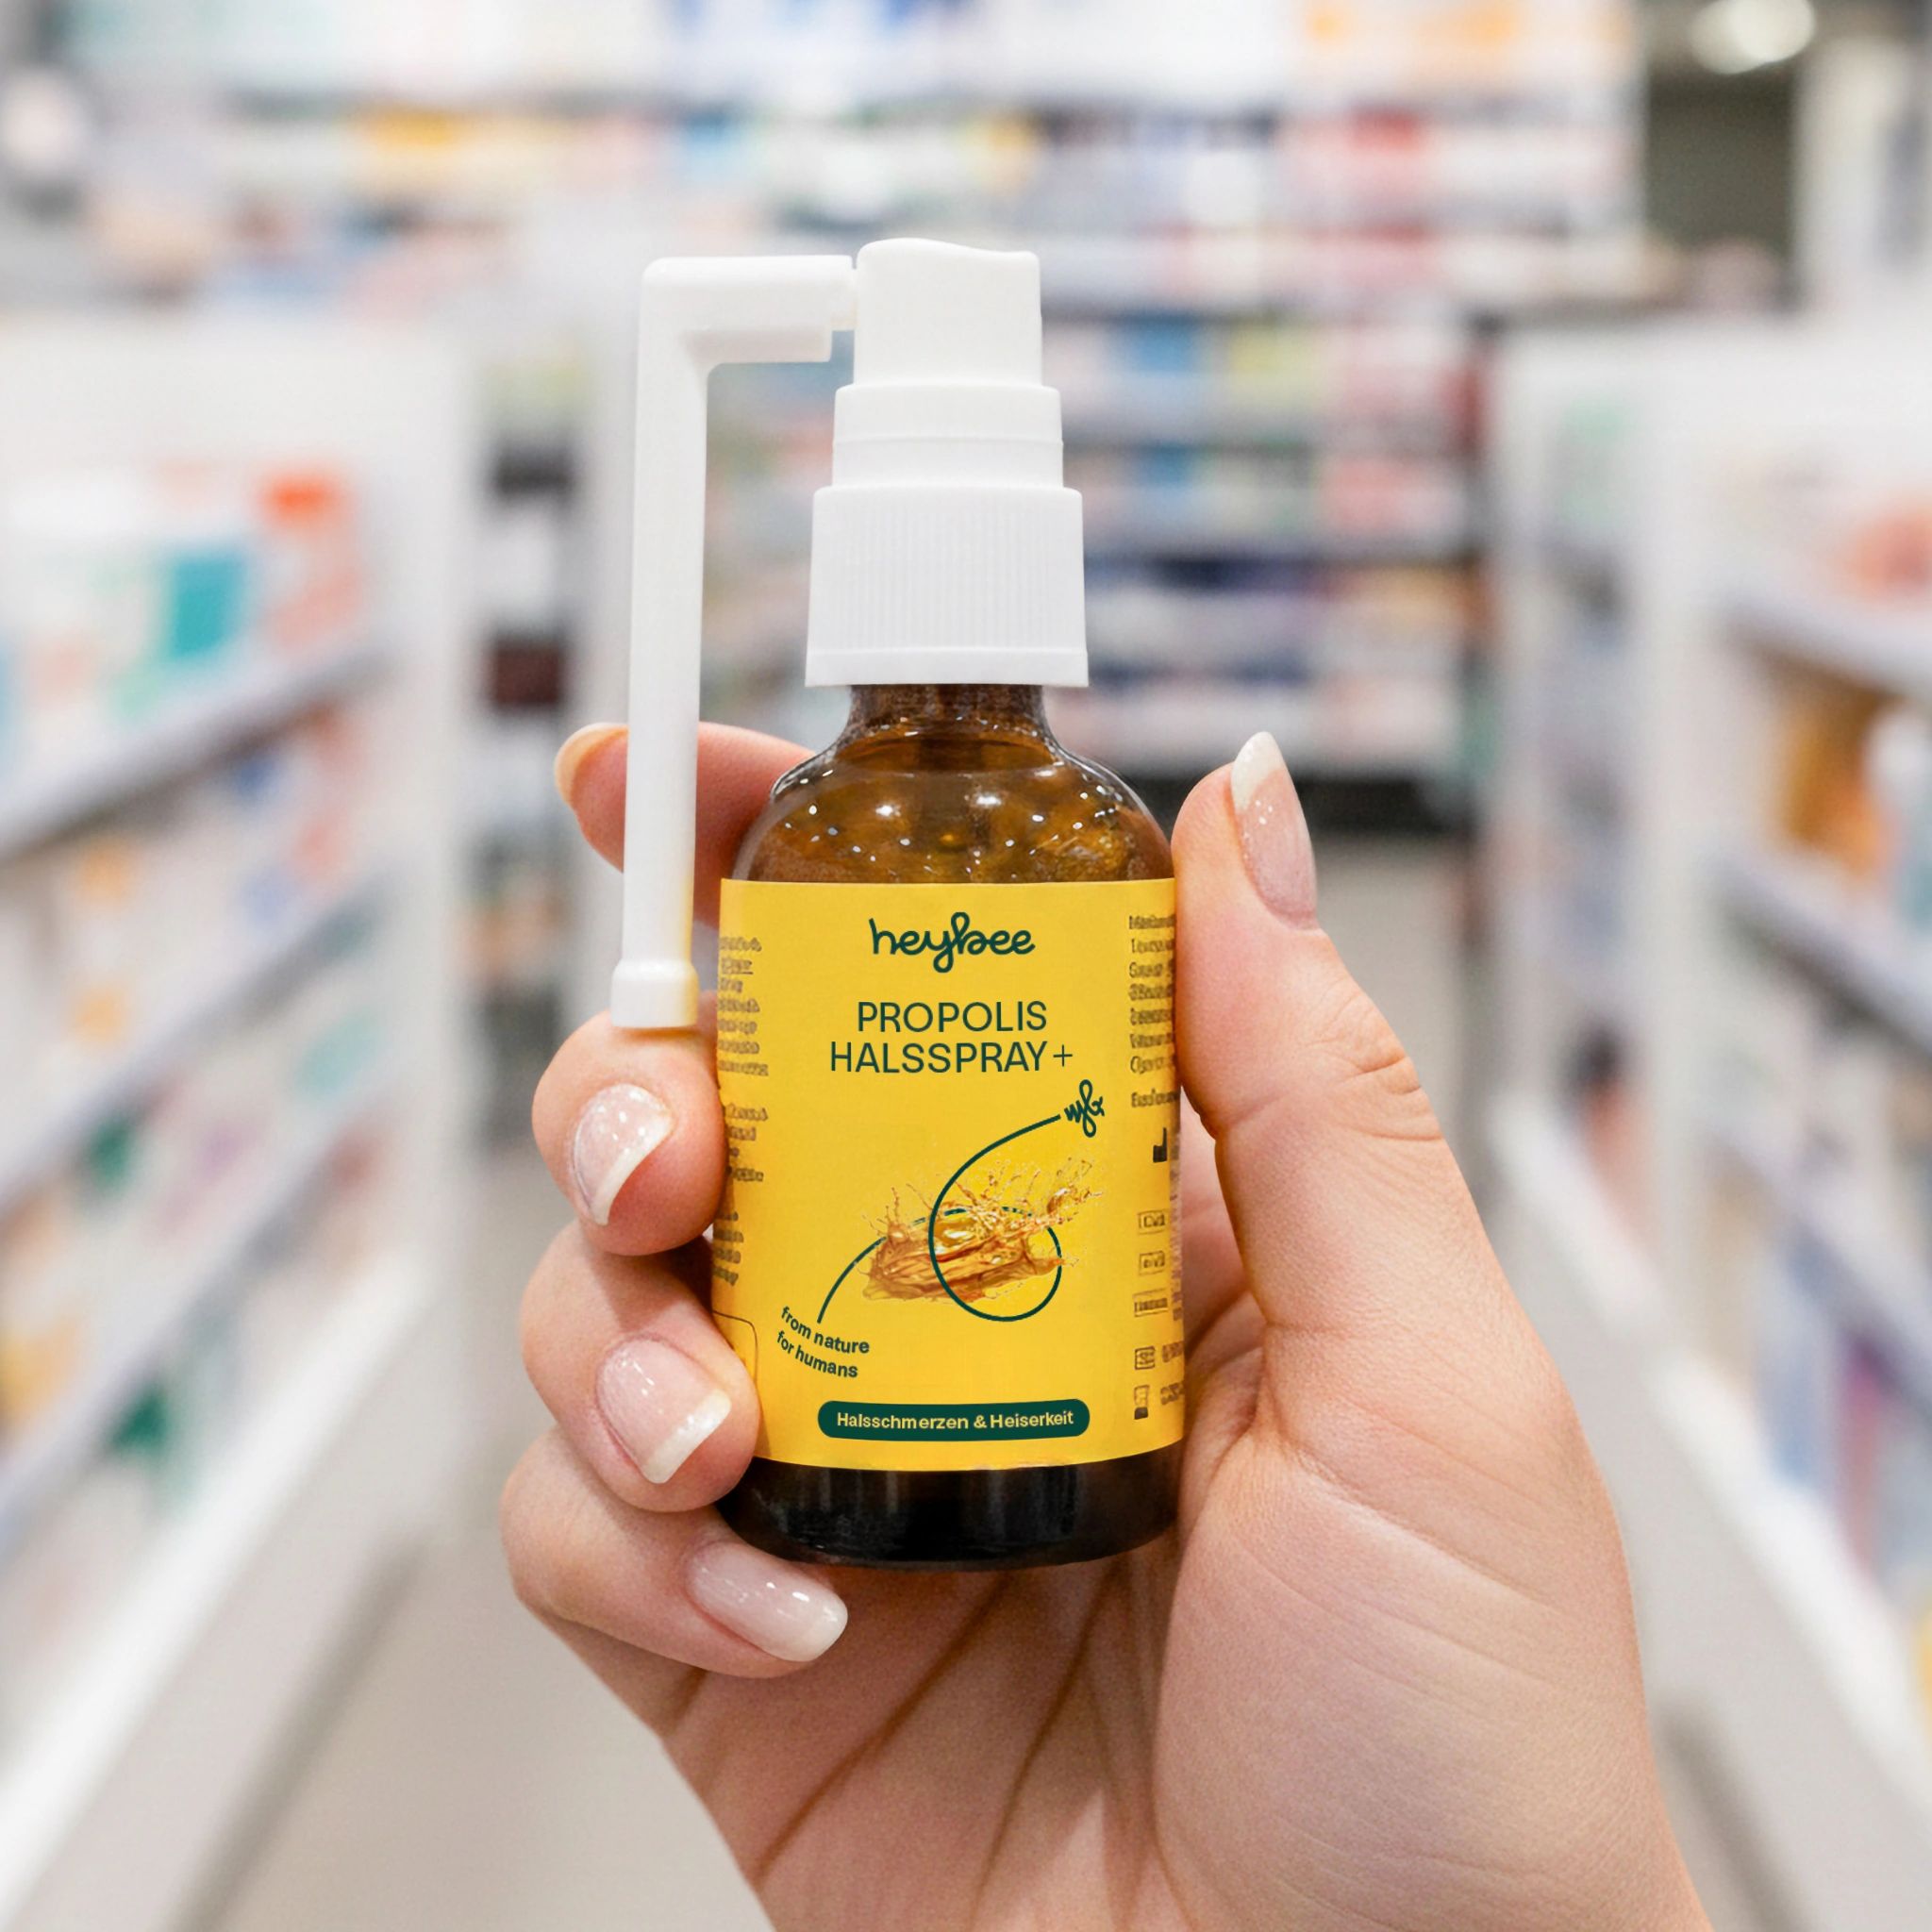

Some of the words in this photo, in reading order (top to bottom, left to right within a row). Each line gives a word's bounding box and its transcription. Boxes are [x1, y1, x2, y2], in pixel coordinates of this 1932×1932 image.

[869, 911, 1036, 974] heybee
[858, 1001, 1047, 1032] PROPOLIS
[776, 1330, 794, 1355] for
[794, 1344, 858, 1378] humans
[781, 1306, 812, 1340] from
[813, 1332, 870, 1354] nature
[837, 1411, 969, 1430] Halsschmerzen
[973, 1414, 988, 1429] &
[990, 1410, 1074, 1428] Heiserkeit
